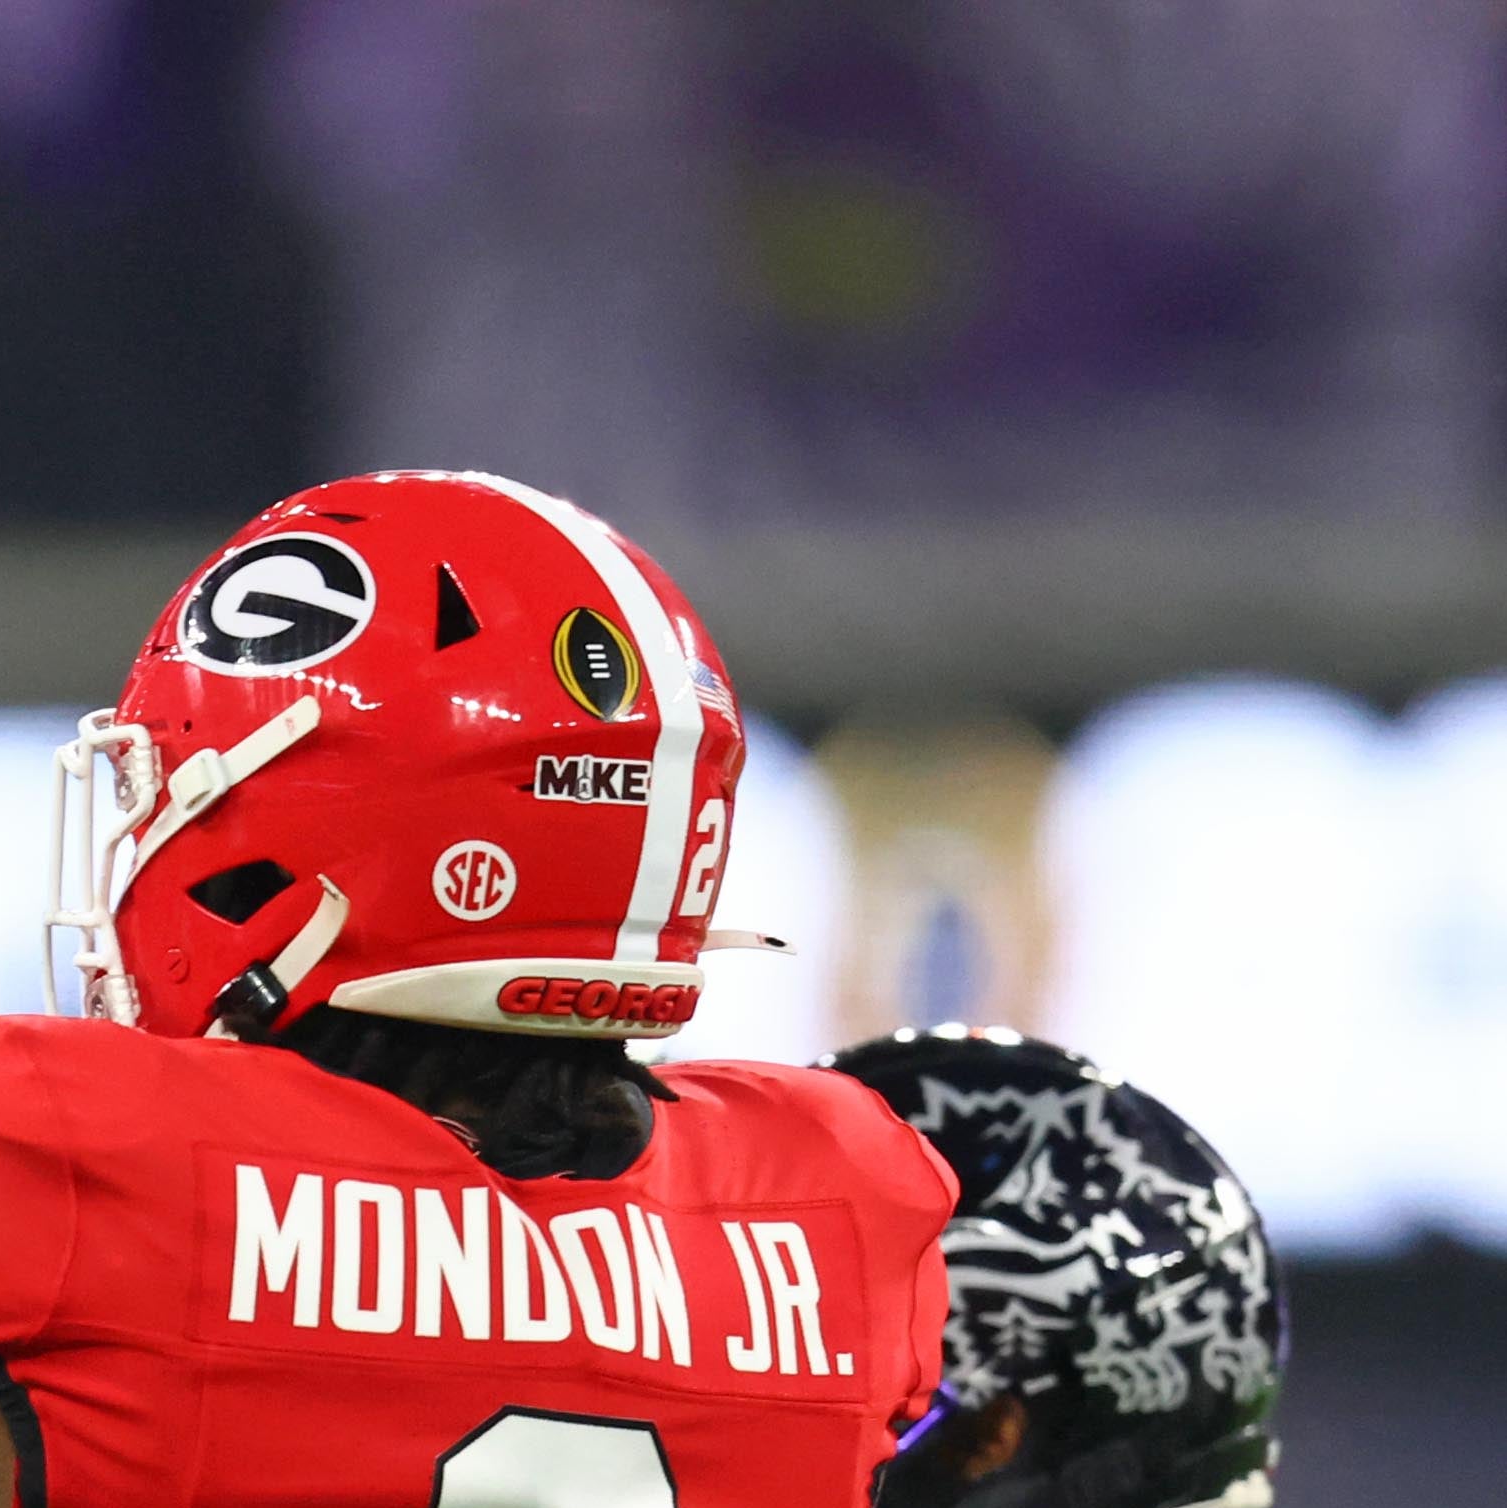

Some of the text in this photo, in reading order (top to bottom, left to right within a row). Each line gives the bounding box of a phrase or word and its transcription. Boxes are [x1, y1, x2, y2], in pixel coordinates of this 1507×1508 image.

[178, 532, 376, 677] G
[445, 850, 506, 911] SEC
[678, 798, 726, 916] 2
[228, 1164, 854, 1376] MONDON JR.
